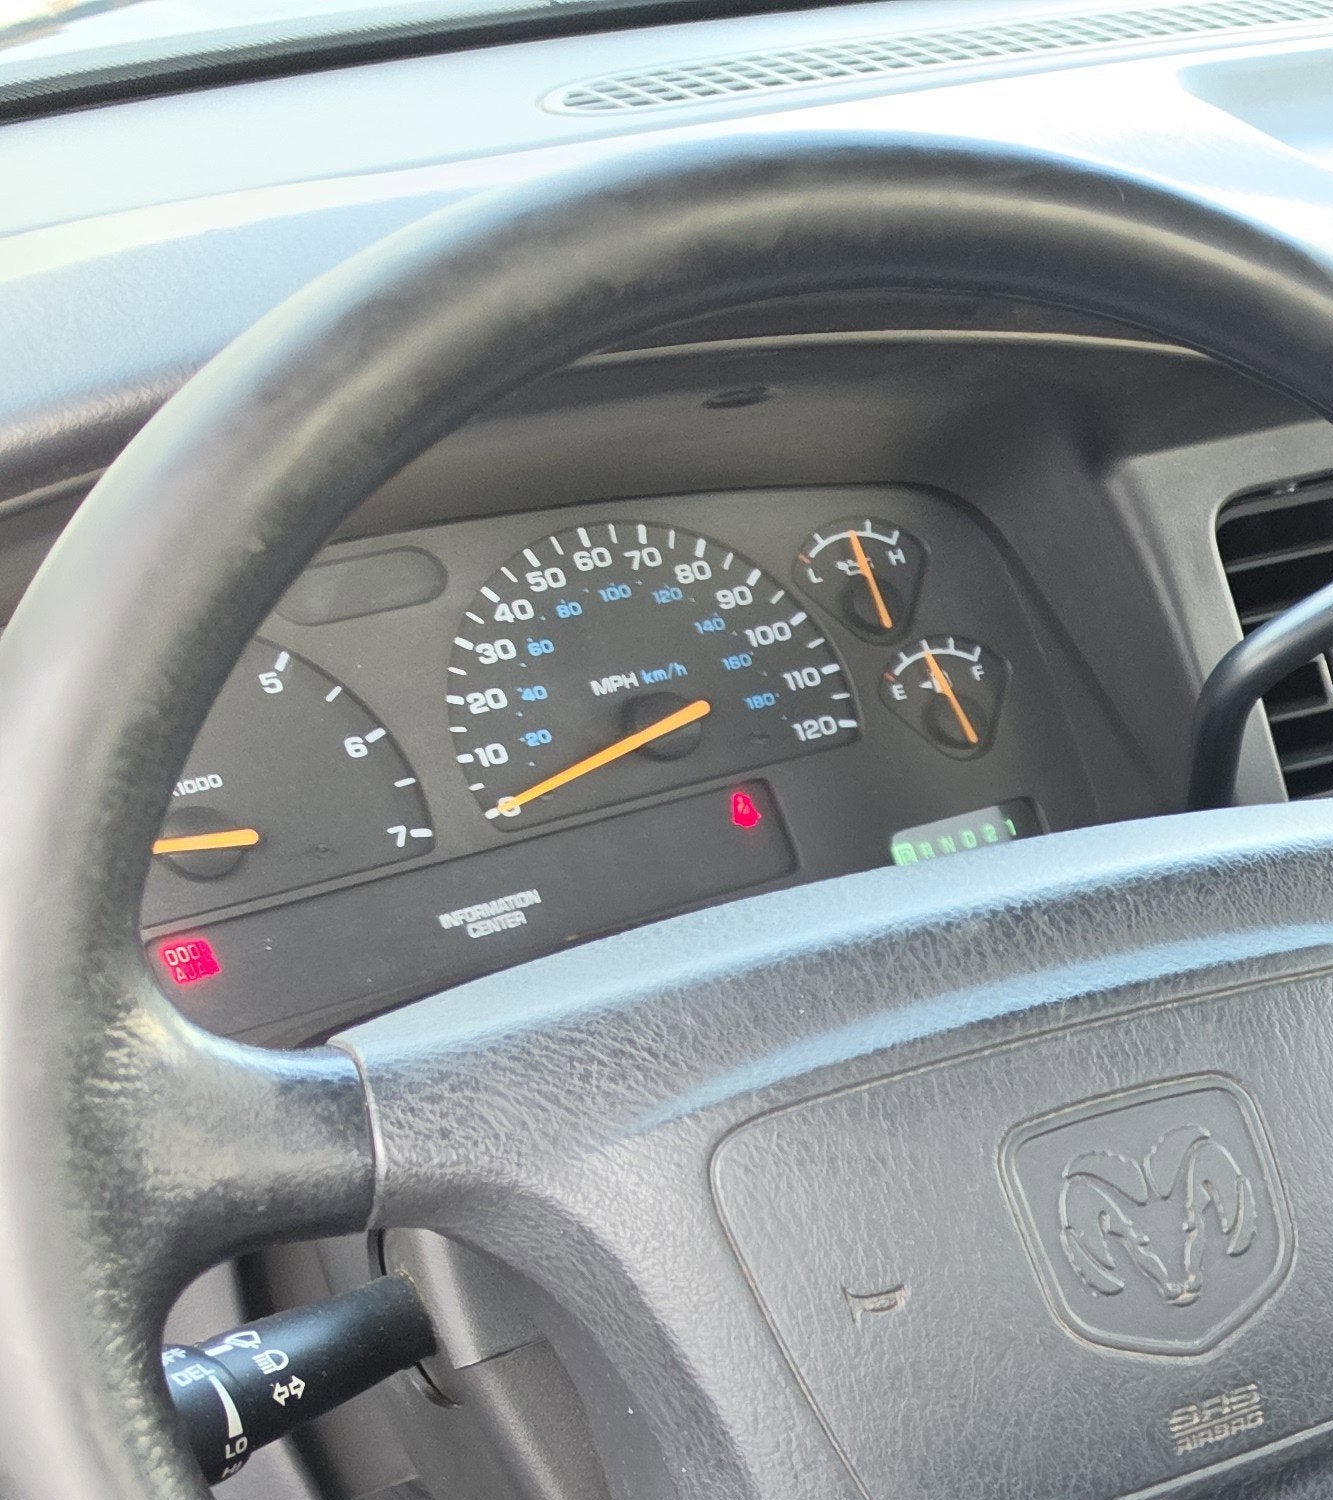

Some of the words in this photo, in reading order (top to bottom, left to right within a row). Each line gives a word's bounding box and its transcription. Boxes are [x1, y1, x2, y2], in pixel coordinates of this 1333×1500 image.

[573, 547, 612, 571] 60
[624, 547, 662, 570] 70
[887, 548, 906, 566] H
[526, 567, 567, 592] 50
[675, 560, 712, 585] 80
[599, 582, 632, 602] 100
[653, 585, 683, 605] 120
[716, 584, 753, 609] 90
[494, 599, 534, 622] 40
[556, 602, 582, 618] 80
[695, 615, 726, 634] 140
[746, 621, 792, 648] 100
[475, 638, 516, 664] 30
[528, 639, 554, 655] 60
[721, 653, 752, 670] 160
[971, 664, 985, 681] F
[259, 671, 284, 694] 5
[590, 670, 639, 698] MPH
[641, 662, 688, 686] km/h
[782, 667, 821, 691] 110
[466, 687, 507, 715] 20
[522, 685, 548, 701] 40
[745, 693, 775, 710] 180
[891, 684, 907, 700] E
[524, 729, 552, 747] 20
[794, 716, 837, 742] 120
[344, 737, 369, 758] 6
[473, 743, 509, 767] 10
[387, 825, 406, 847] 7
[438, 889, 541, 929] INFORMATION
[467, 910, 527, 938] CENTER
[171, 1363, 215, 1387] DEL
[225, 1436, 248, 1460] LO
